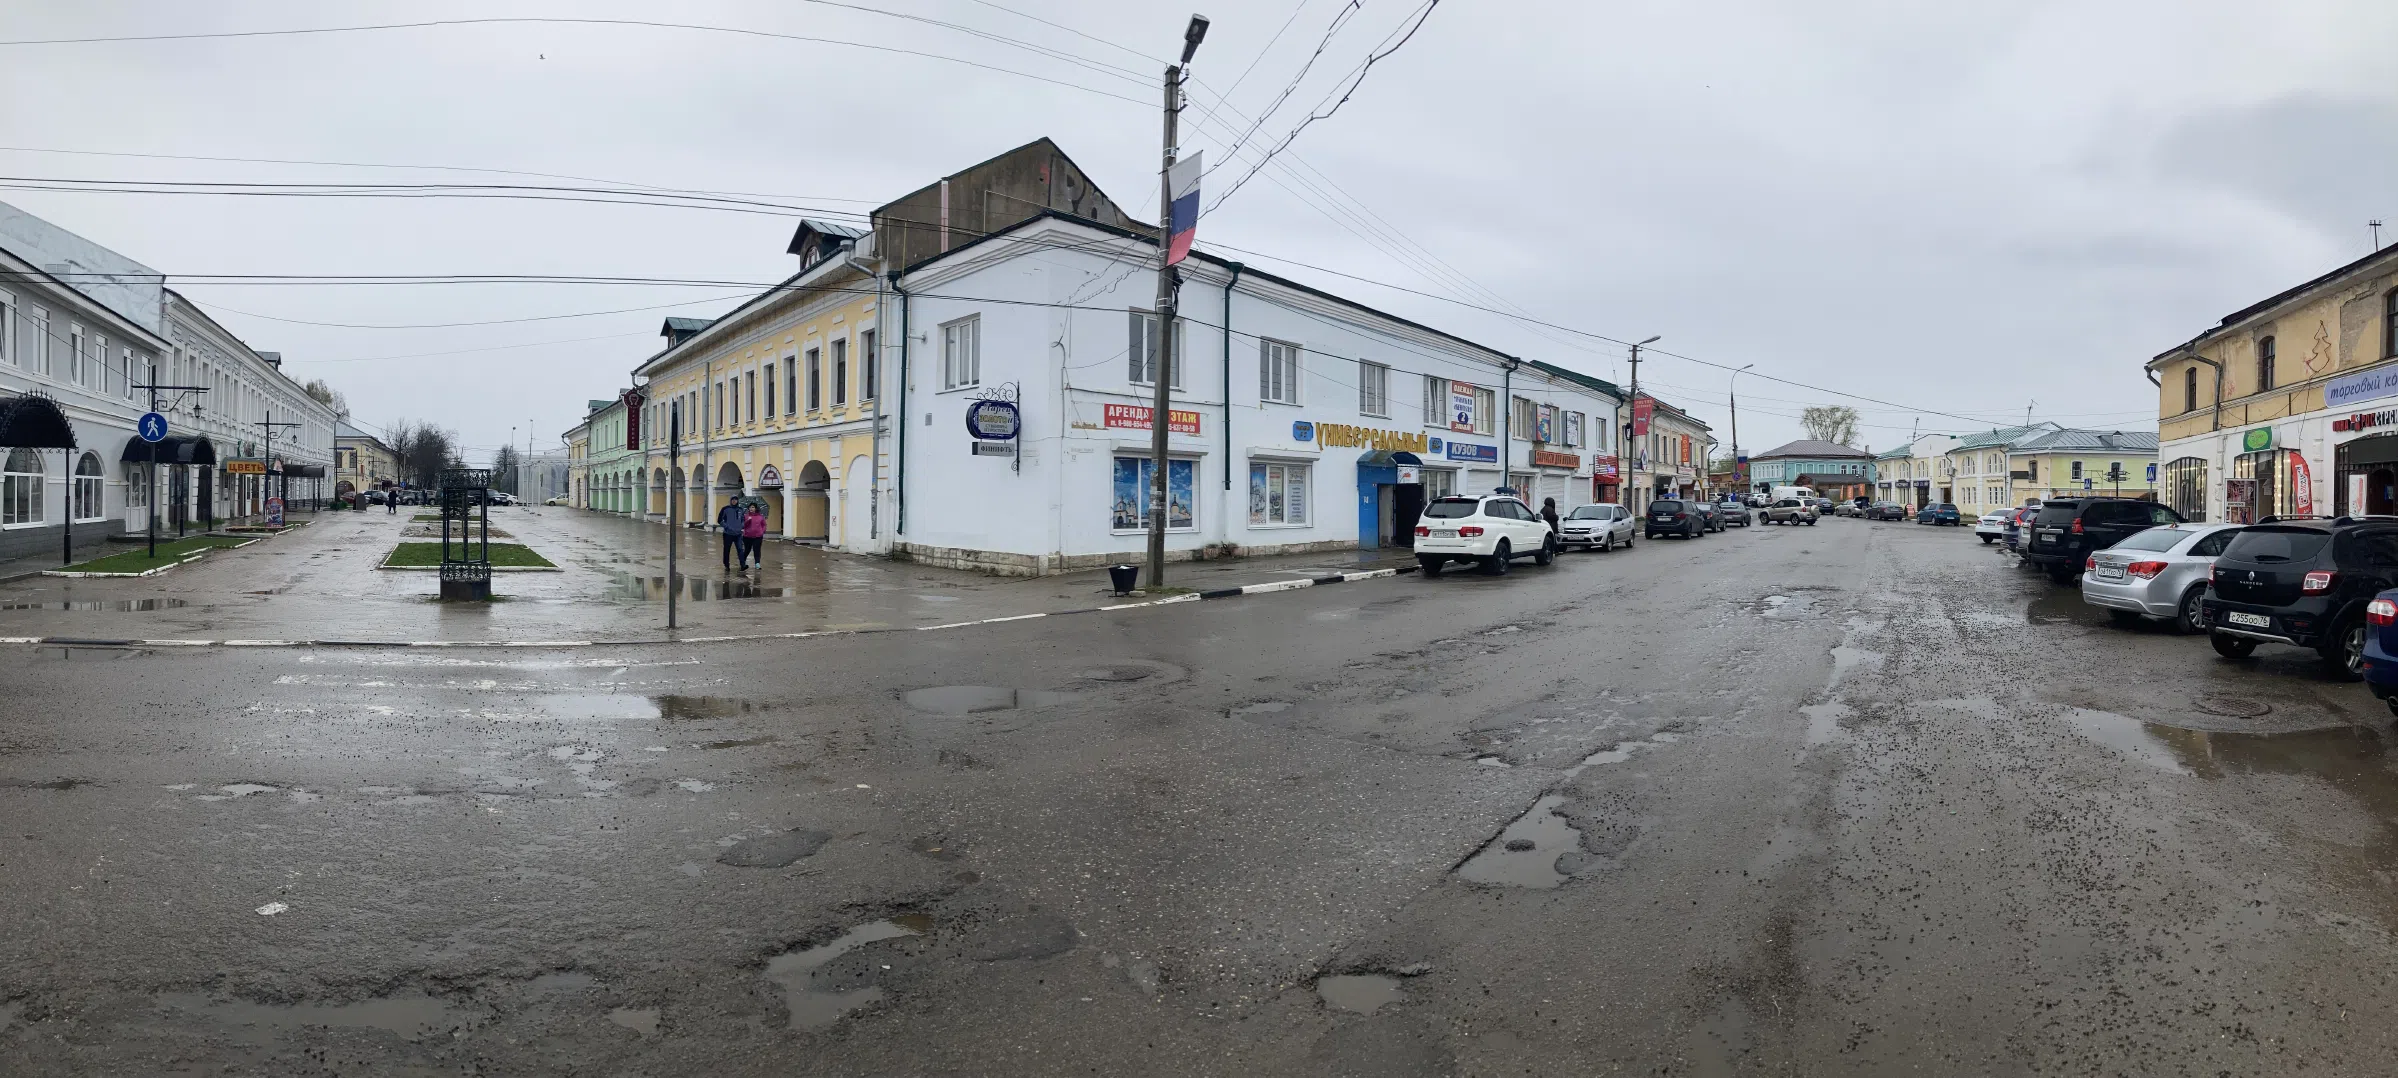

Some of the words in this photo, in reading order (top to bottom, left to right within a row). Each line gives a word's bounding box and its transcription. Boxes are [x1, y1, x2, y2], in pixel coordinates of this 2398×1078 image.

[2330, 375, 2380, 399] торговый
[1108, 406, 1149, 420] АРЕНДА
[1170, 411, 1197, 423] ЭТАЖ
[1460, 412, 1466, 422] 2
[1315, 421, 1428, 454] УНИВЕРСАЛЬНЫЙ
[981, 445, 1012, 453] ФИНИФТЬ
[1451, 443, 1478, 456] КУЗОВ
[229, 463, 267, 473] ЦВЕТЫ
